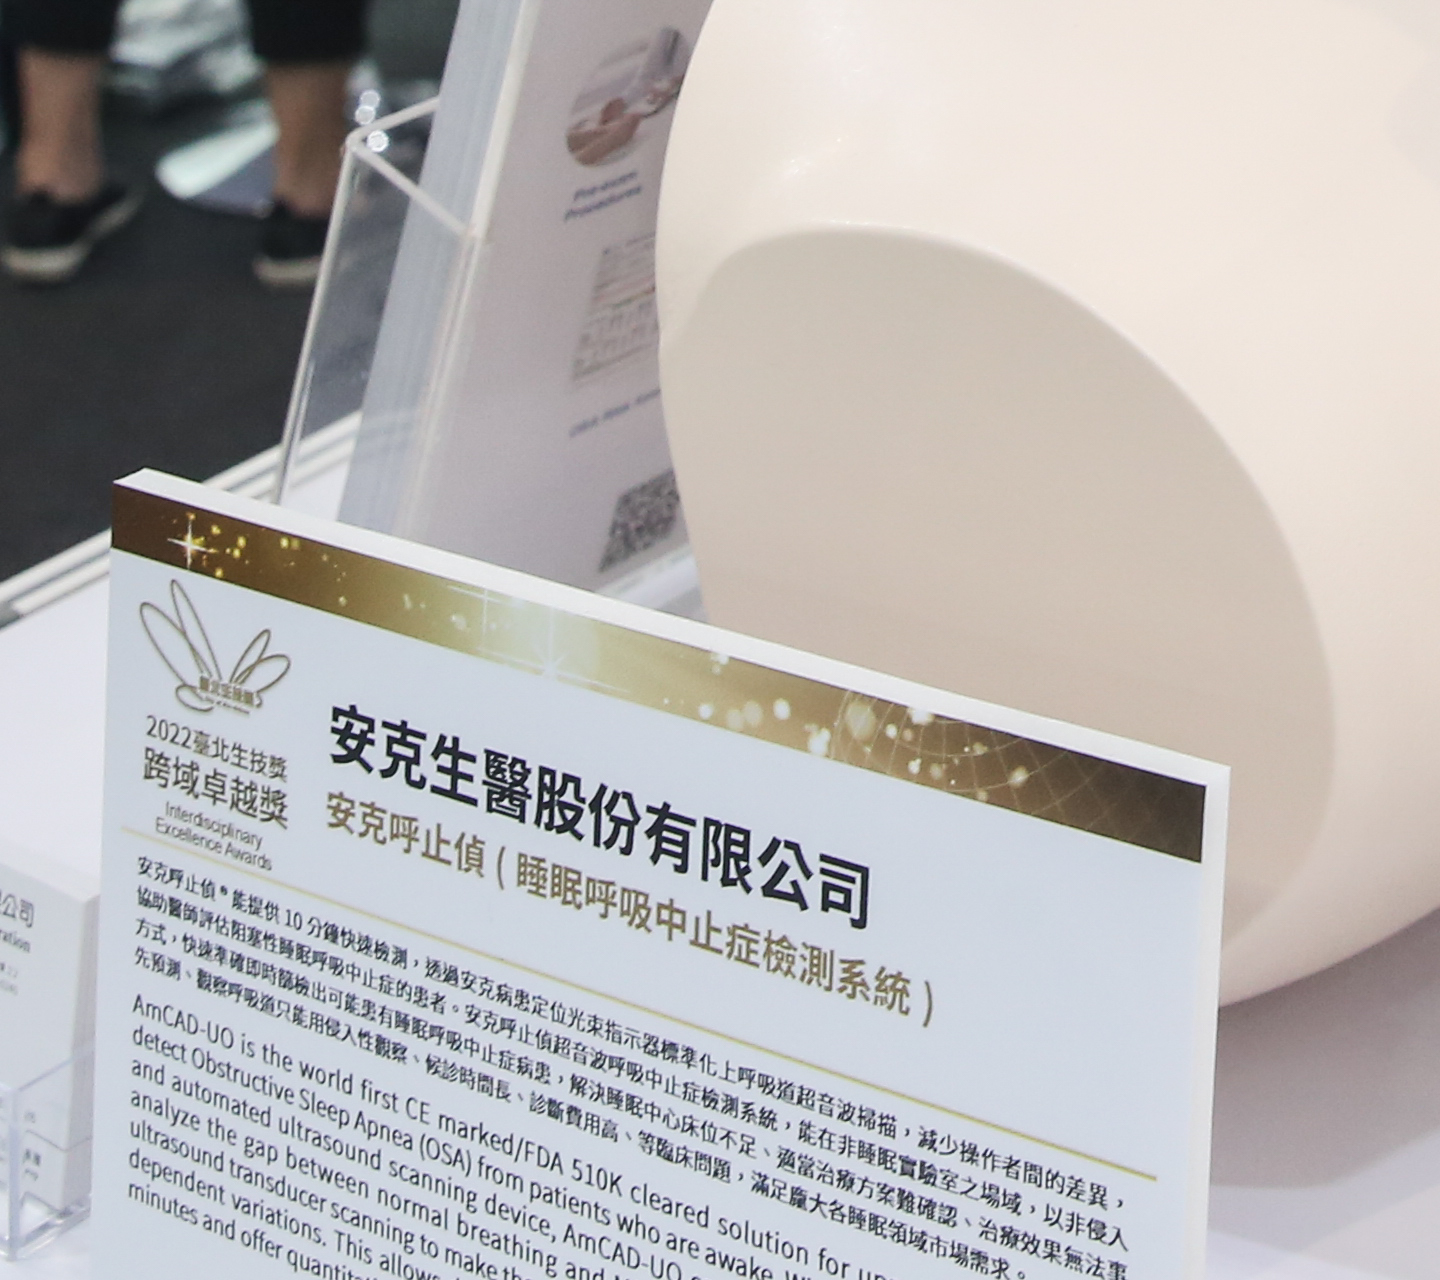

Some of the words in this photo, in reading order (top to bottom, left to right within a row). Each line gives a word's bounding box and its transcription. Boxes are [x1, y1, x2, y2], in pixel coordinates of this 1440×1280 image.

[142, 746, 288, 829] 跨域卓越獎
[145, 714, 287, 782] 2022臺北生技獎
[162, 801, 265, 851] Interdisciplinary
[328, 703, 870, 930] 安克生醫股份有限公司
[155, 816, 224, 853] Excellence
[224, 841, 272, 870] Awards
[326, 790, 485, 878] 安克呼止偵
[516, 851, 910, 1016] 睡眠呼吸中止症檢測系統
[128, 1147, 225, 1205] dependent
[230, 1192, 326, 1246] variations.
[333, 1228, 372, 1265] This
[130, 1089, 200, 1131] analyze
[206, 1116, 237, 1146] the
[243, 1135, 278, 1166] gap
[285, 1144, 369, 1199] between
[376, 1187, 448, 1231] normal
[456, 1210, 558, 1280] breathing
[130, 1119, 224, 1172] ultrasound
[228, 1157, 327, 1213] transducer
[330, 1201, 415, 1255] scanning
[418, 1233, 439, 1259] to
[444, 1246, 498, 1280] make
[131, 1058, 165, 1086] and
[168, 1074, 271, 1128] automated
[278, 1114, 381, 1171] ultrasound
[388, 1159, 478, 1214] scanning
[483, 1192, 556, 1243] device,
[561, 1222, 682, 1280] AmCAD-UO
[132, 993, 234, 1049] AmCAD-UO
[240, 1032, 255, 1058] is
[261, 1043, 293, 1072] the
[298, 1060, 353, 1095] world
[359, 1077, 398, 1113] first
[405, 1096, 430, 1125] CE
[437, 1113, 564, 1176] marked/FDA
[570, 1157, 622, 1198] 510K
[629, 1182, 709, 1229] cleared
[716, 1217, 808, 1266] solution
[817, 1246, 851, 1280] for
[132, 1024, 187, 1064] detect
[191, 1047, 295, 1105] Obstructive
[298, 1087, 350, 1130] Sleep
[353, 1109, 413, 1151] Apnea
[419, 1132, 471, 1178] (OSA)
[477, 1154, 524, 1193] from
[528, 1180, 611, 1226] patients
[615, 1212, 661, 1244] who
[664, 1231, 700, 1259] are
[128, 1182, 198, 1225] minutes
[202, 1213, 235, 1240] and
[240, 1227, 283, 1259] offer
